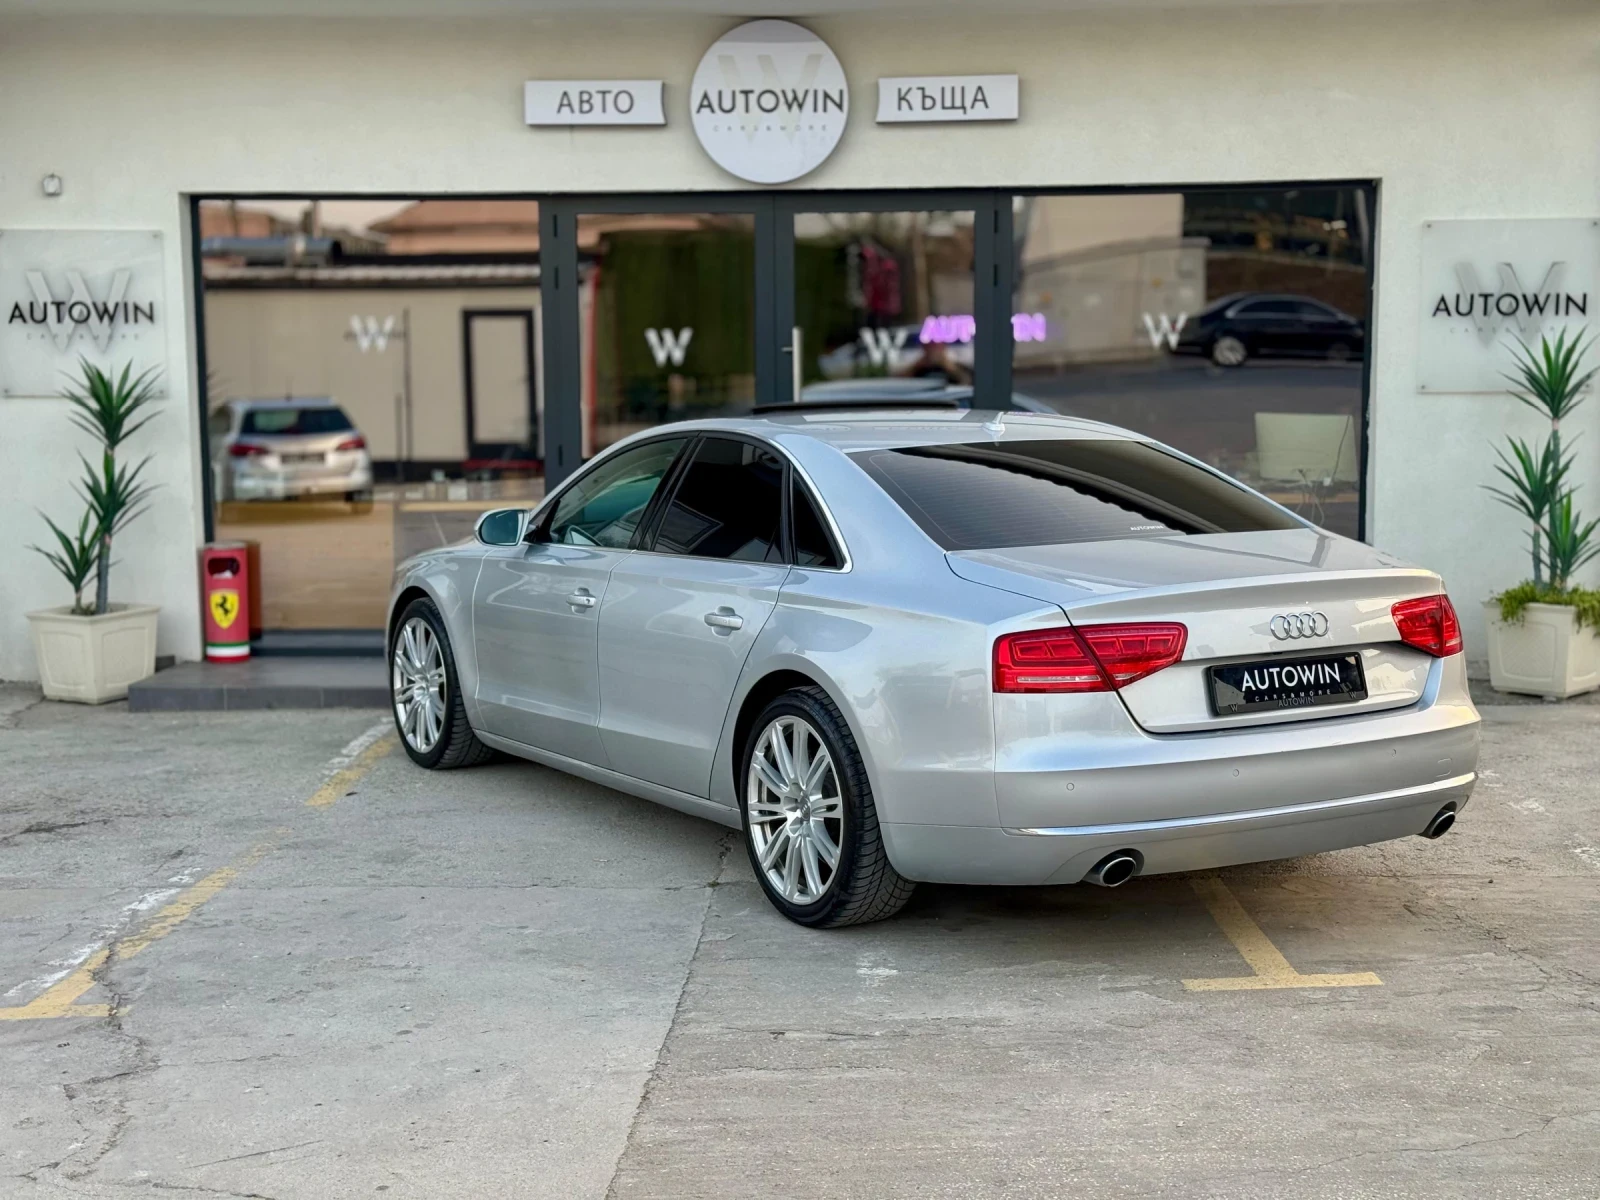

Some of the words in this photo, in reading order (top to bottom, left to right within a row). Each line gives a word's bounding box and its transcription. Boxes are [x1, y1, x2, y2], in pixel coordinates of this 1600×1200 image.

[556, 89, 635, 114] АВТО
[696, 89, 844, 114] AUTOWIN
[897, 85, 990, 115] КЪЩА
[8, 301, 155, 324] AUTOWIN
[1432, 293, 1588, 317] AUTOWIN
[351, 315, 394, 352] W
[1143, 311, 1187, 350] W
[644, 326, 694, 368] W
[860, 327, 908, 371] W
[1241, 662, 1341, 692] AUTOWIN
[1278, 696, 1315, 708] AUTOWIN
